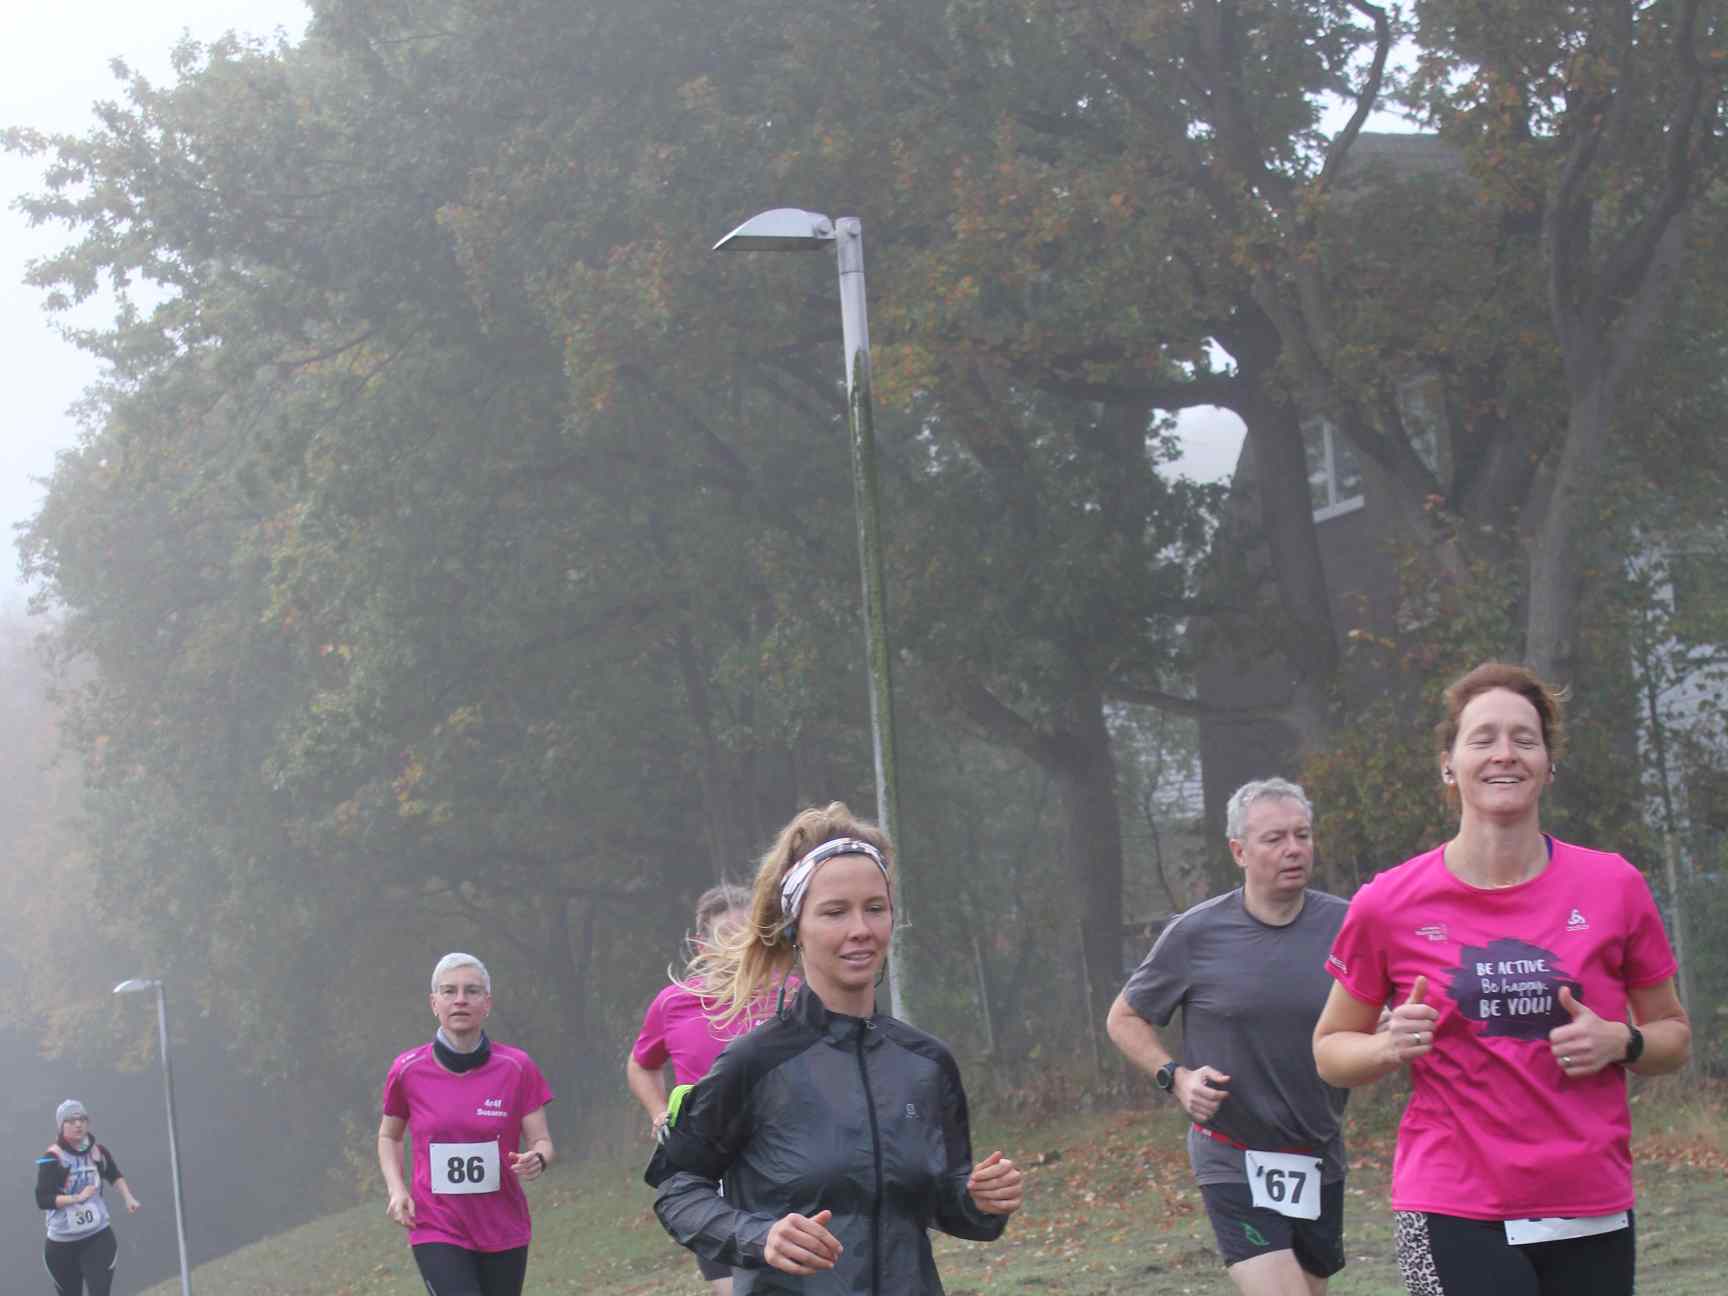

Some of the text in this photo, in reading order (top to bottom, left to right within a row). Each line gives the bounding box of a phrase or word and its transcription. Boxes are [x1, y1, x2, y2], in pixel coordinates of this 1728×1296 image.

[1476, 962, 1495, 976] BE
[1480, 996, 1552, 1018] BE YOU!
[447, 1156, 485, 1183] 86
